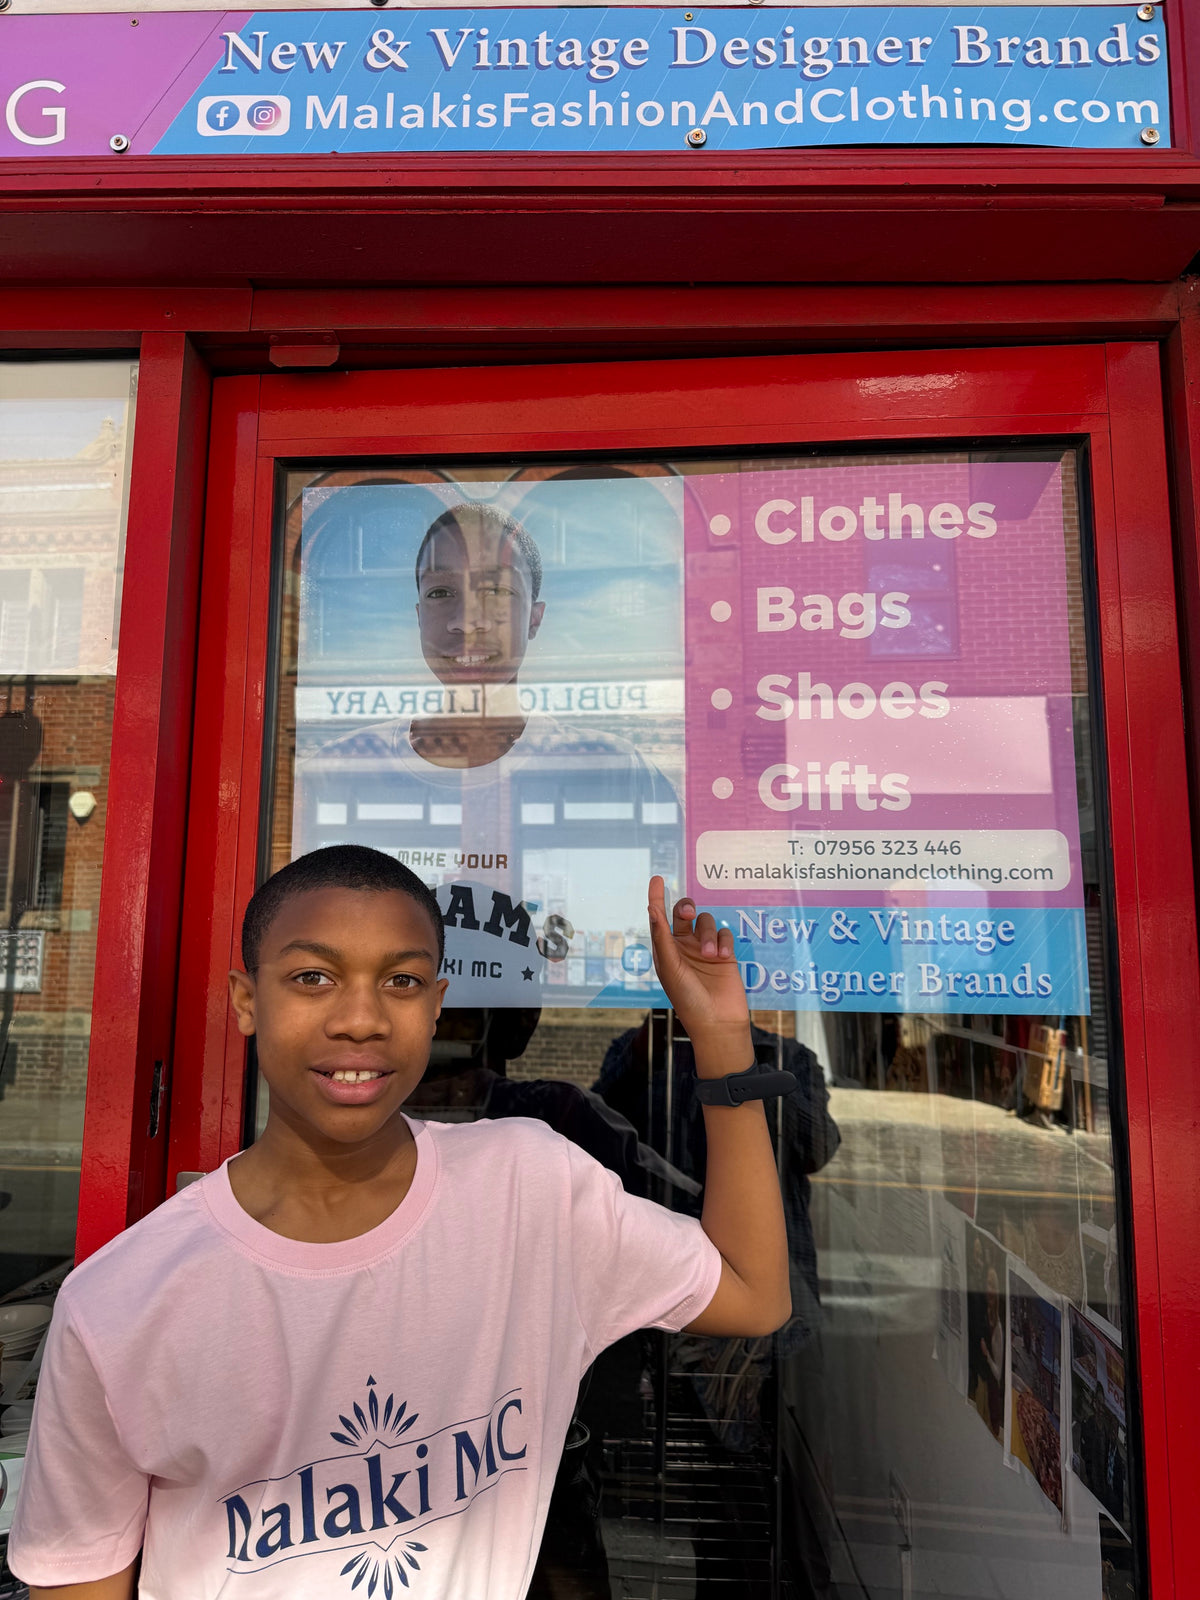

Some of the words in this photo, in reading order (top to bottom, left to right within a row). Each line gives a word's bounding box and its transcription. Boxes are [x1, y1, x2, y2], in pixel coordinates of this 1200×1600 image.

[221, 30, 347, 73] New
[365, 28, 412, 71] &
[430, 28, 650, 80] Vintage
[670, 25, 934, 79] Designer
[952, 22, 1161, 67] Brands
[5, 80, 67, 146] G
[305, 85, 1160, 132] MalakisFashionAndClothing.com
[754, 492, 998, 546] Clothes
[756, 586, 912, 640] Bags
[755, 672, 951, 722] Shoes
[758, 761, 912, 813] Gifts
[397, 850, 447, 868] MAKE
[454, 853, 508, 870] YOUR
[788, 840, 804, 856] T:
[814, 840, 875, 856] 07956
[881, 840, 918, 856] 323
[923, 840, 962, 856] 446
[703, 864, 729, 880] W:
[734, 863, 1054, 884] malakisfashionandclothing.com
[433, 884, 575, 963] AMS
[736, 910, 818, 944] New
[829, 910, 861, 943] &
[869, 910, 1016, 953] Vintage
[471, 960, 503, 979] MC
[739, 961, 906, 1003] Designer
[917, 962, 1053, 998] Brands
[452, 1398, 528, 1502] MC
